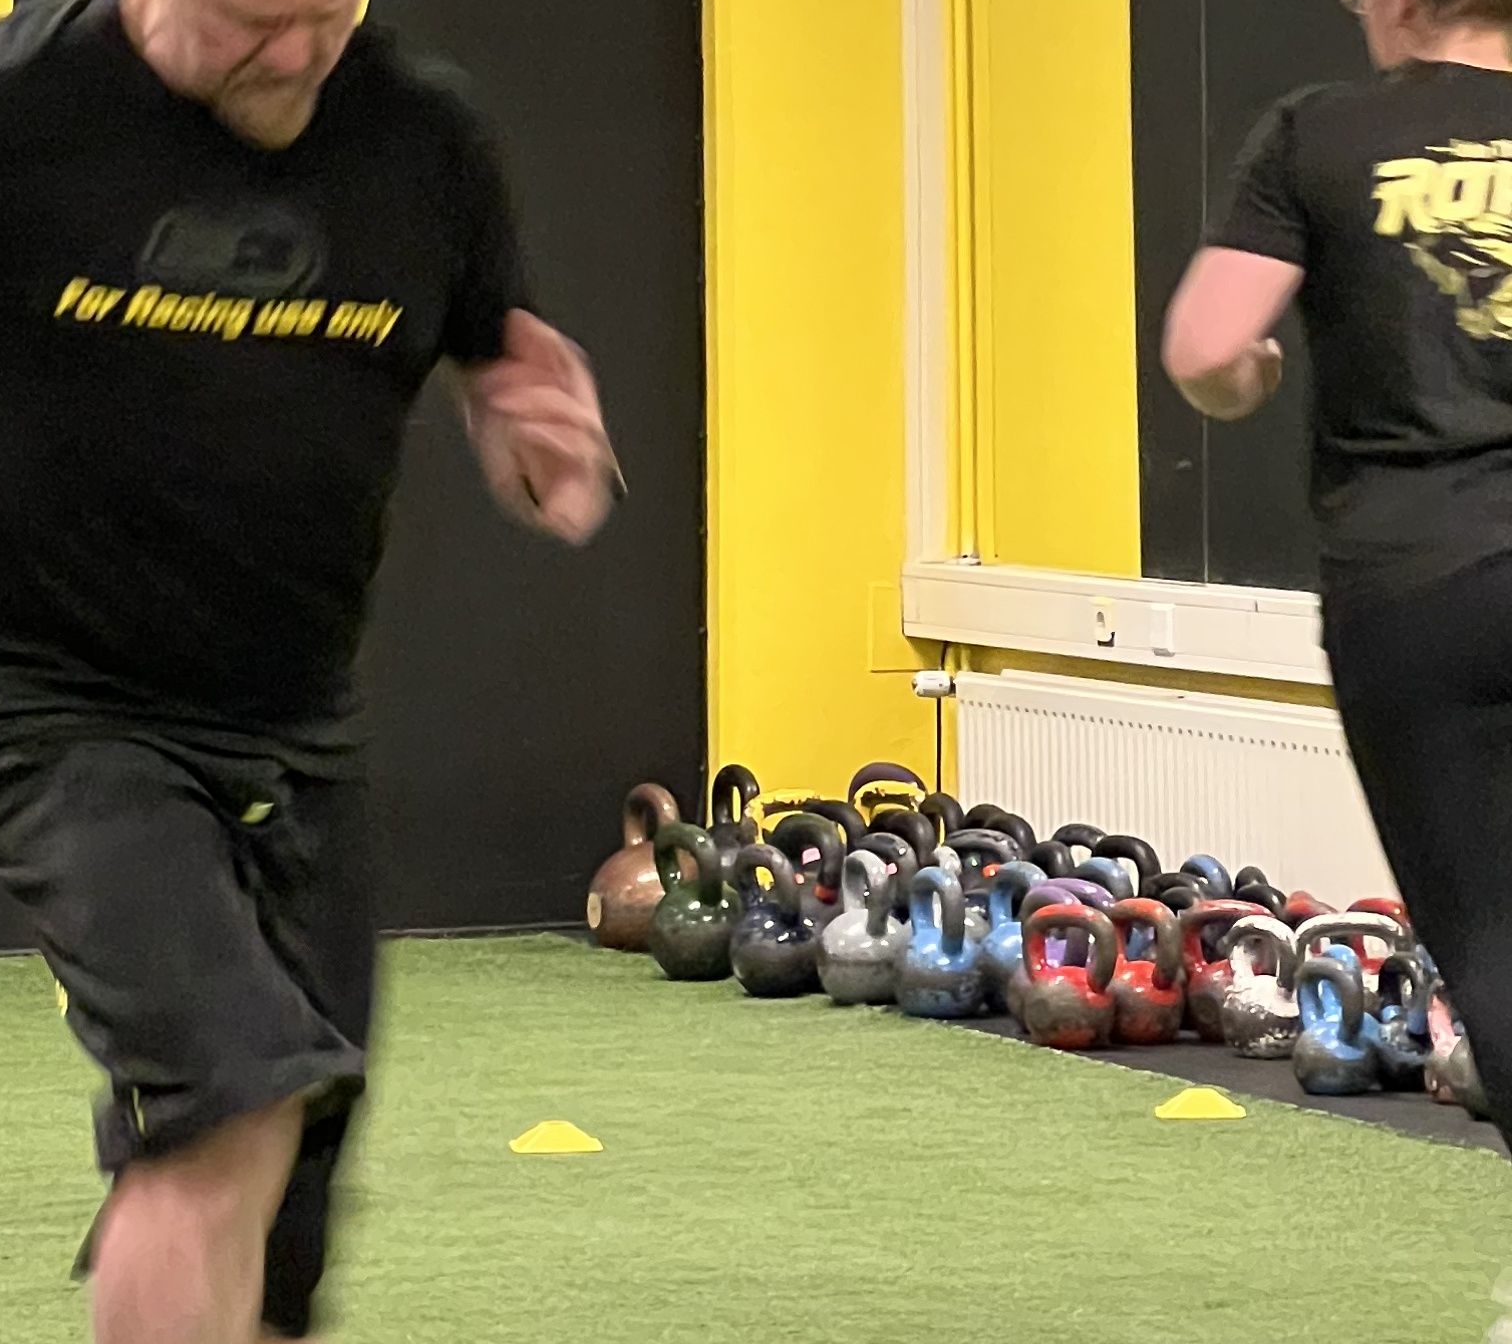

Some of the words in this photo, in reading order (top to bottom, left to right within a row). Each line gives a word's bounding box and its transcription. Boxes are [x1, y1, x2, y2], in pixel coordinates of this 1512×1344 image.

[53, 276, 126, 322] For
[121, 284, 255, 341] Racing
[325, 299, 403, 348] only
